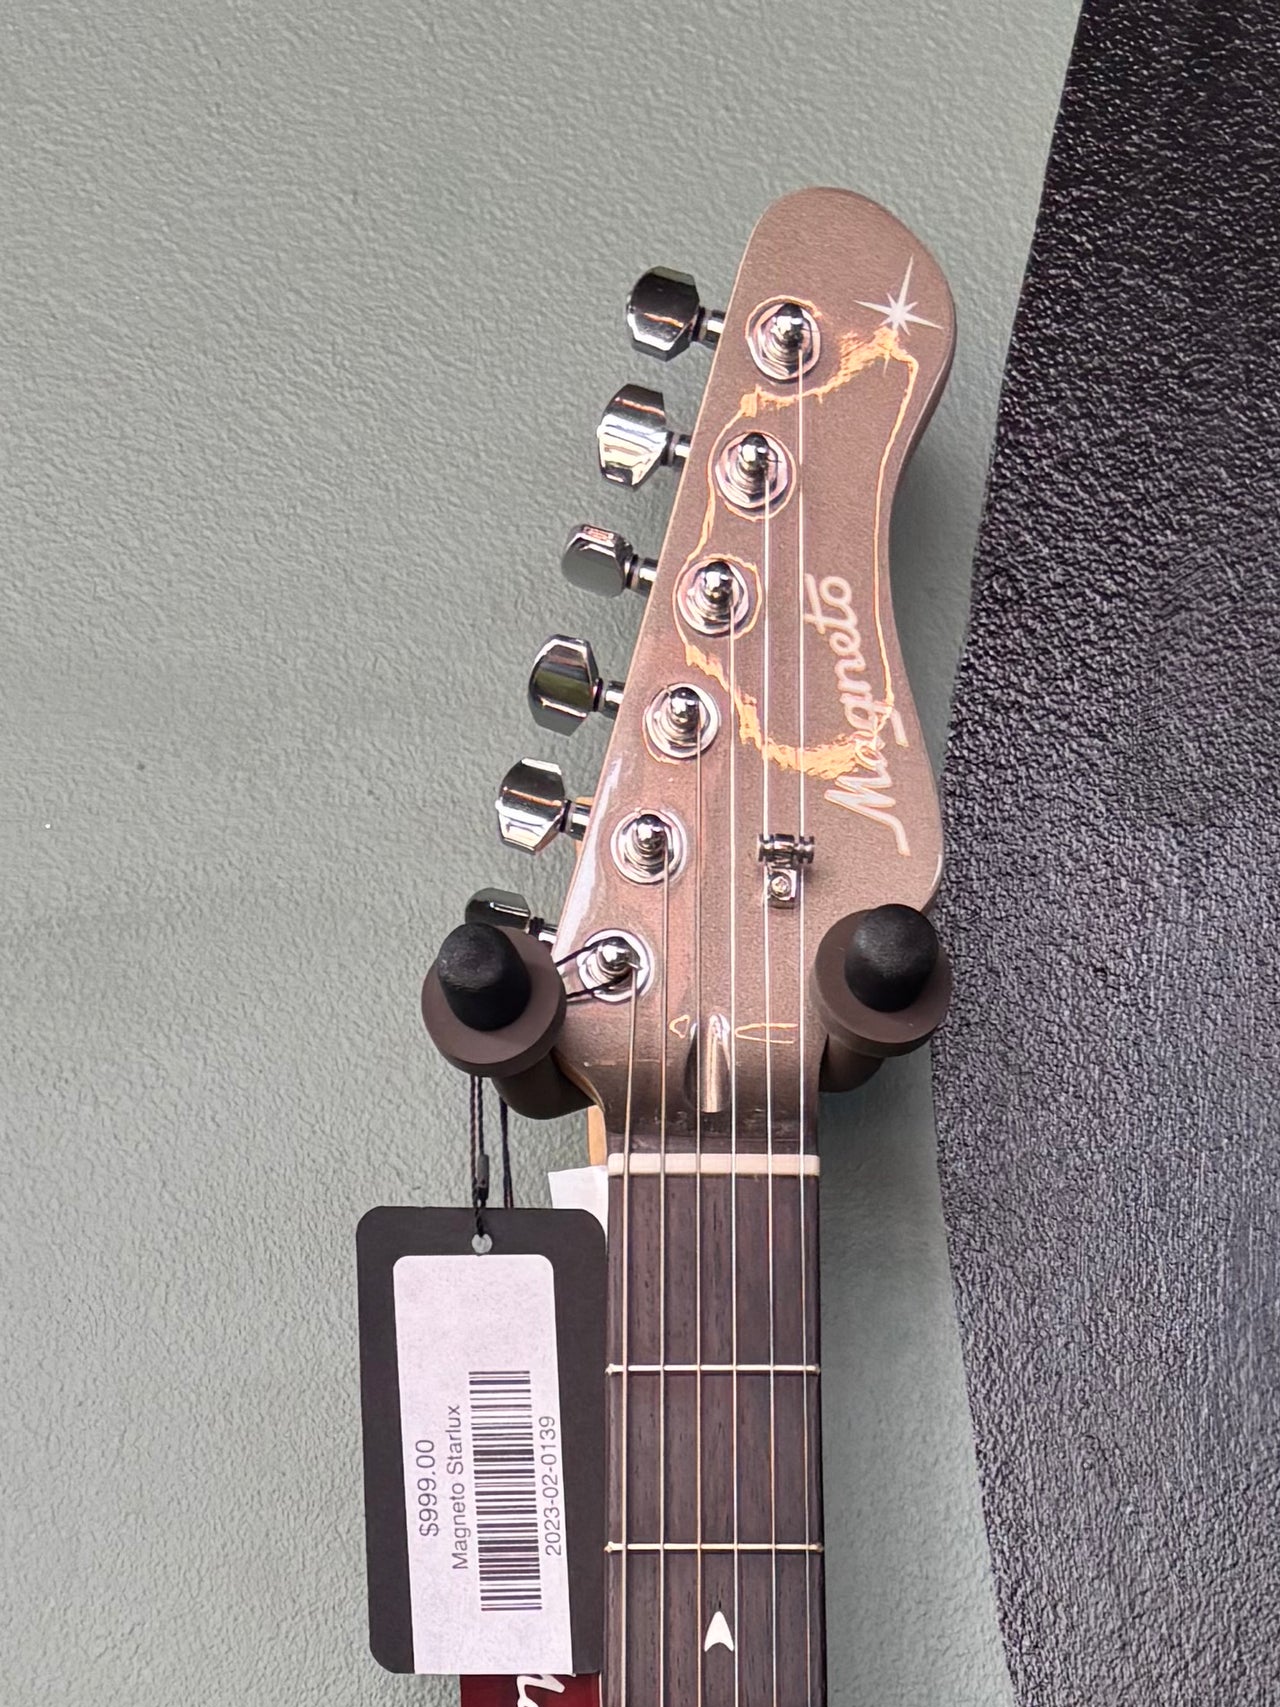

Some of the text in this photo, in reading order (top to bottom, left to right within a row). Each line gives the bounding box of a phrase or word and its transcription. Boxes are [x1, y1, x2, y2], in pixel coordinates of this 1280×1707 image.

[803, 571, 912, 857] Magneto
[415, 1439, 440, 1537] $999.00
[444, 1404, 472, 1570] Magneto Starlux
[538, 1415, 563, 1557] 2023-02-0139
